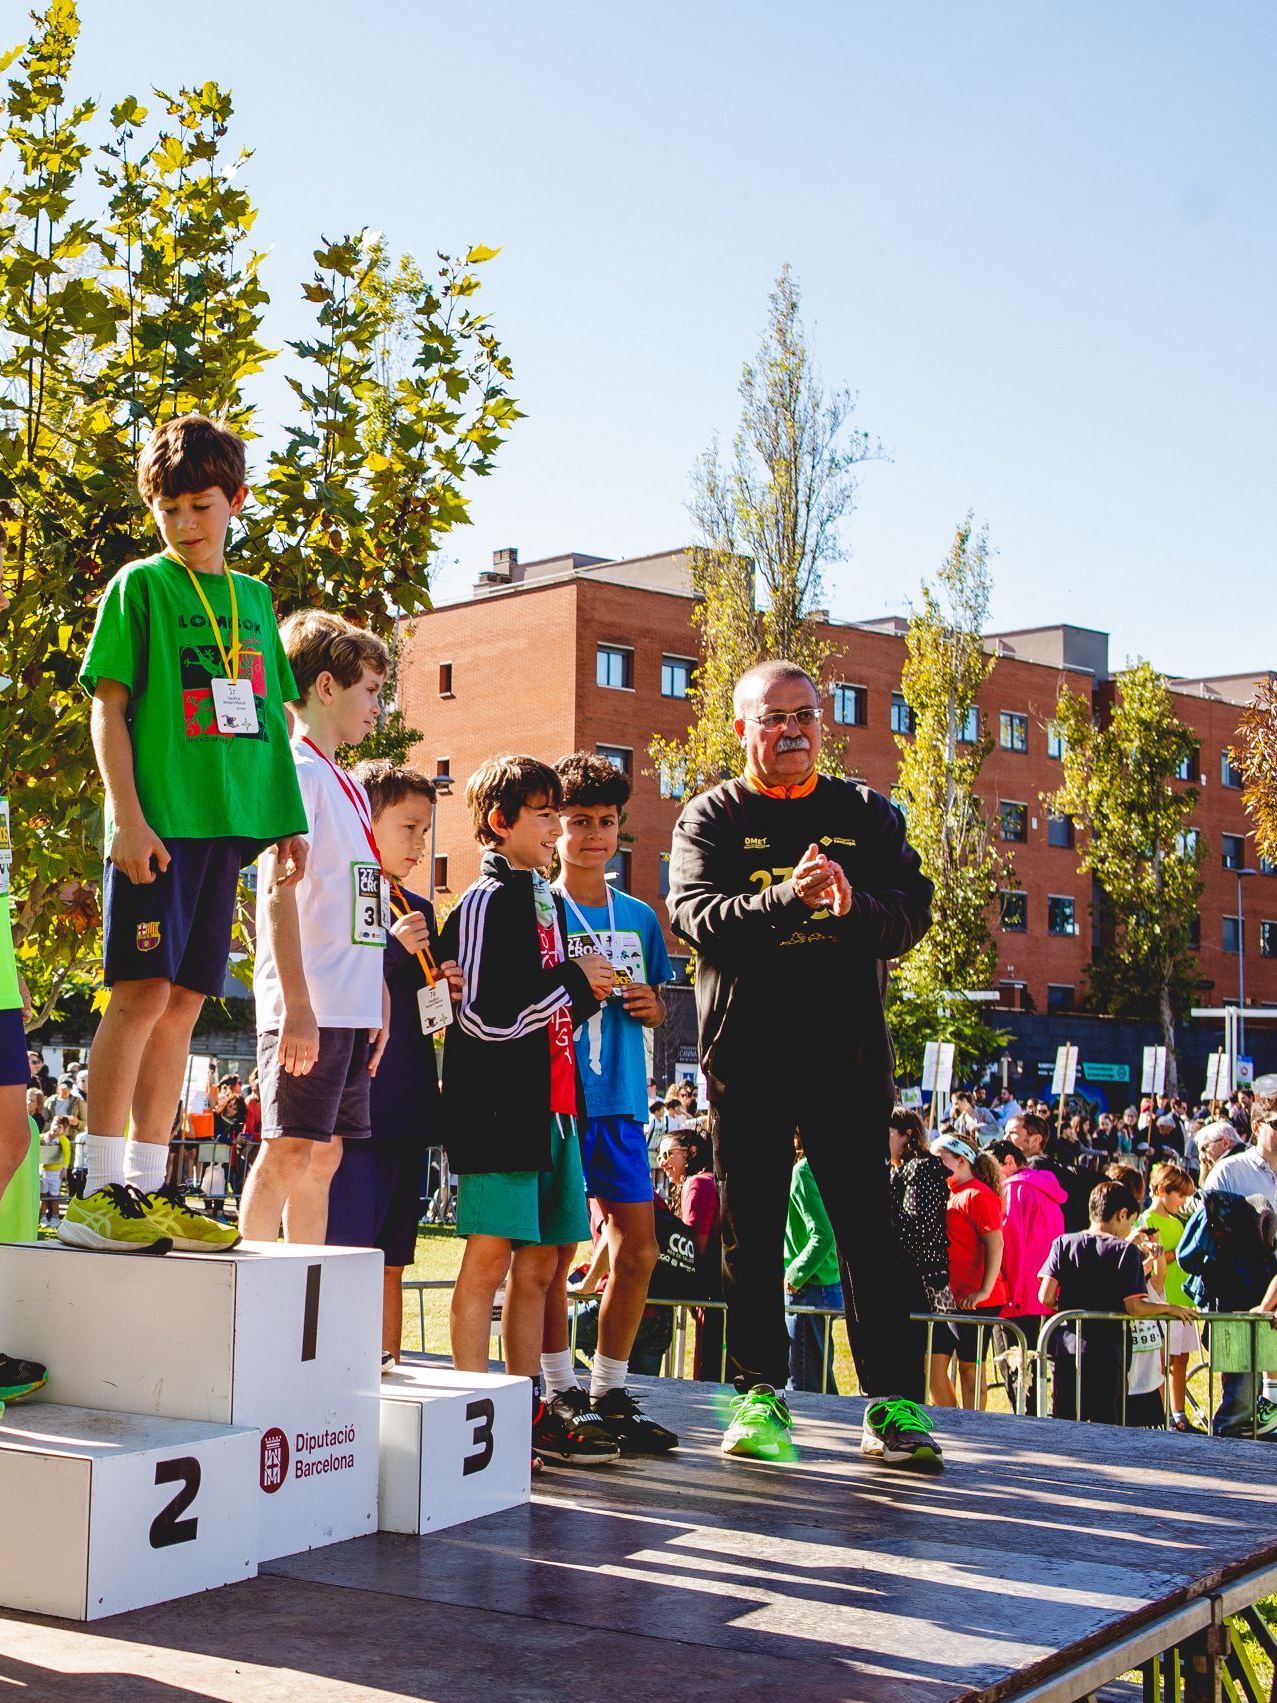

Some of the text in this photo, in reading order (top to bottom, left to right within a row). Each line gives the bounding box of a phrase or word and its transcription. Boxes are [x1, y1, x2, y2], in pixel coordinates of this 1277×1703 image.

[744, 837, 768, 845] OMET
[295, 1424, 355, 1454] Diputació
[462, 1398, 495, 1477] 3
[295, 1453, 355, 1479] Barcelona
[149, 1456, 202, 1549] 2
